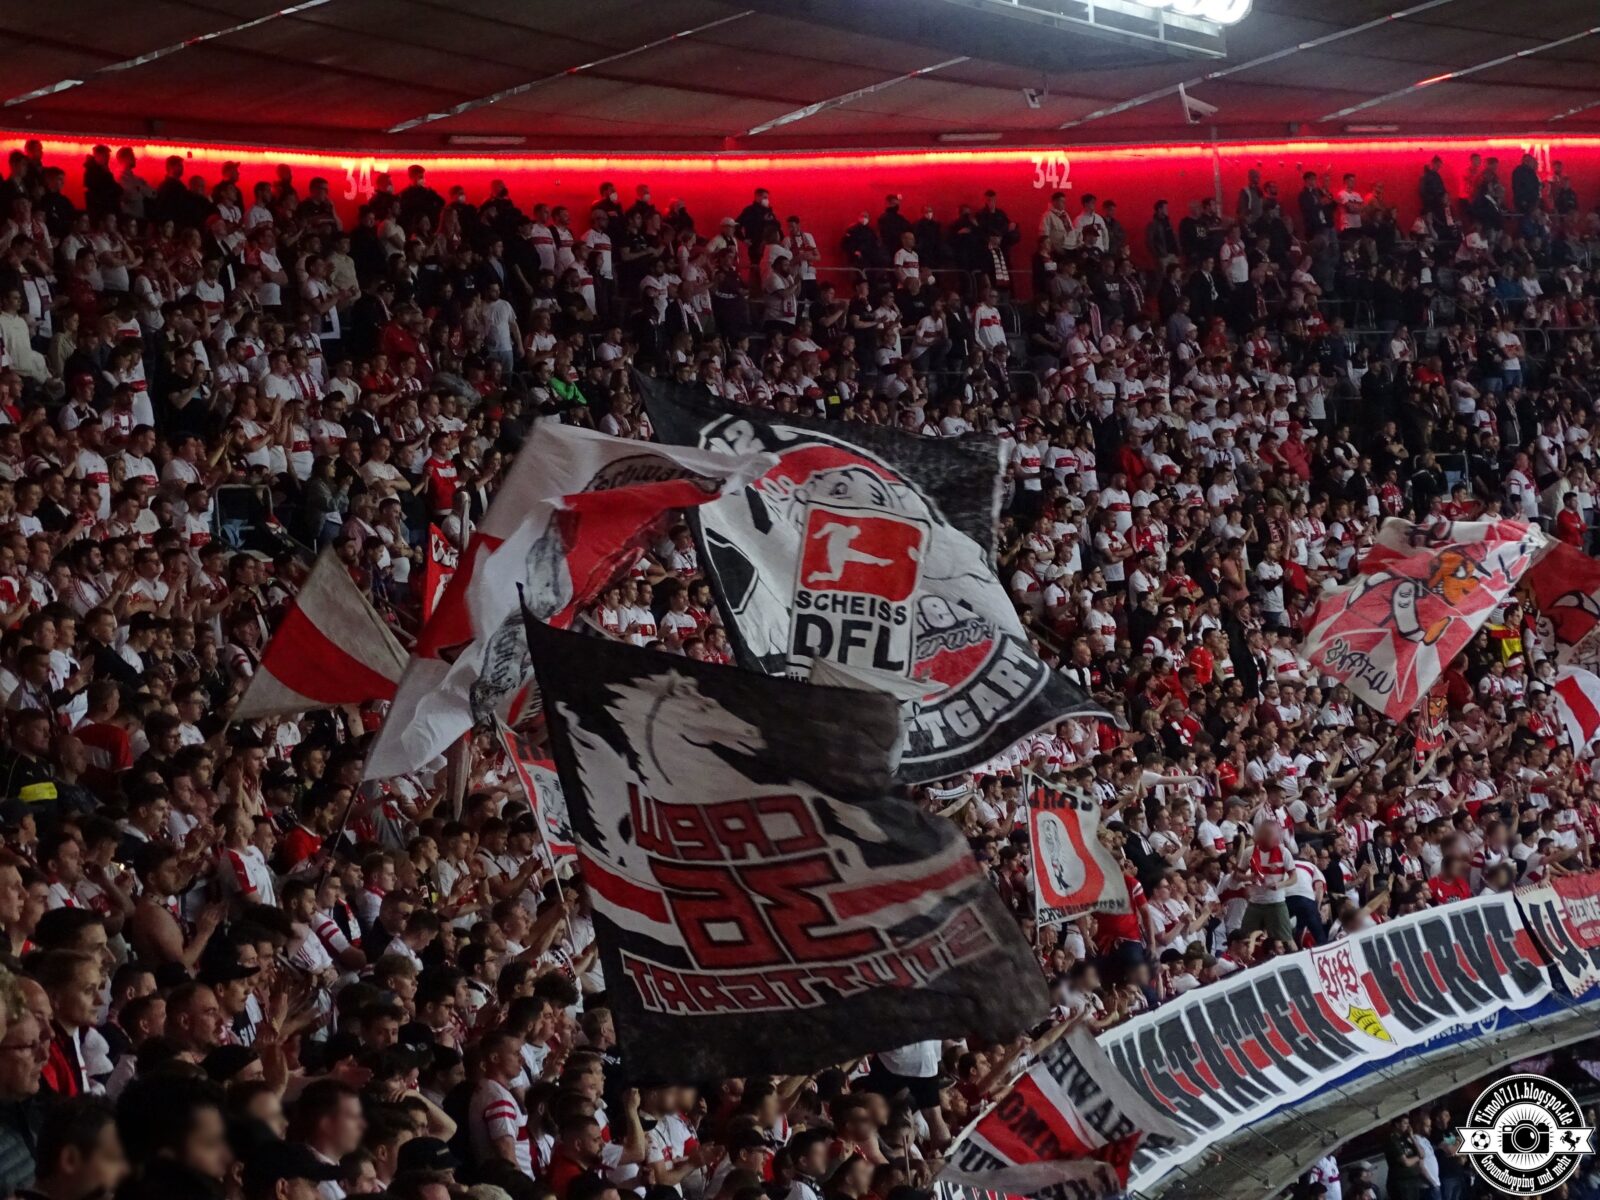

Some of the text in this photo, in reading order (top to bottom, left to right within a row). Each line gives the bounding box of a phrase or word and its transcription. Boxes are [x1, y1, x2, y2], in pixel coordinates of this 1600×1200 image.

[341, 158, 389, 200] 34
[1031, 151, 1072, 189] 342
[795, 590, 907, 626] SCHEISS
[793, 613, 904, 672] DFL
[1362, 902, 1545, 1034] KURVE
